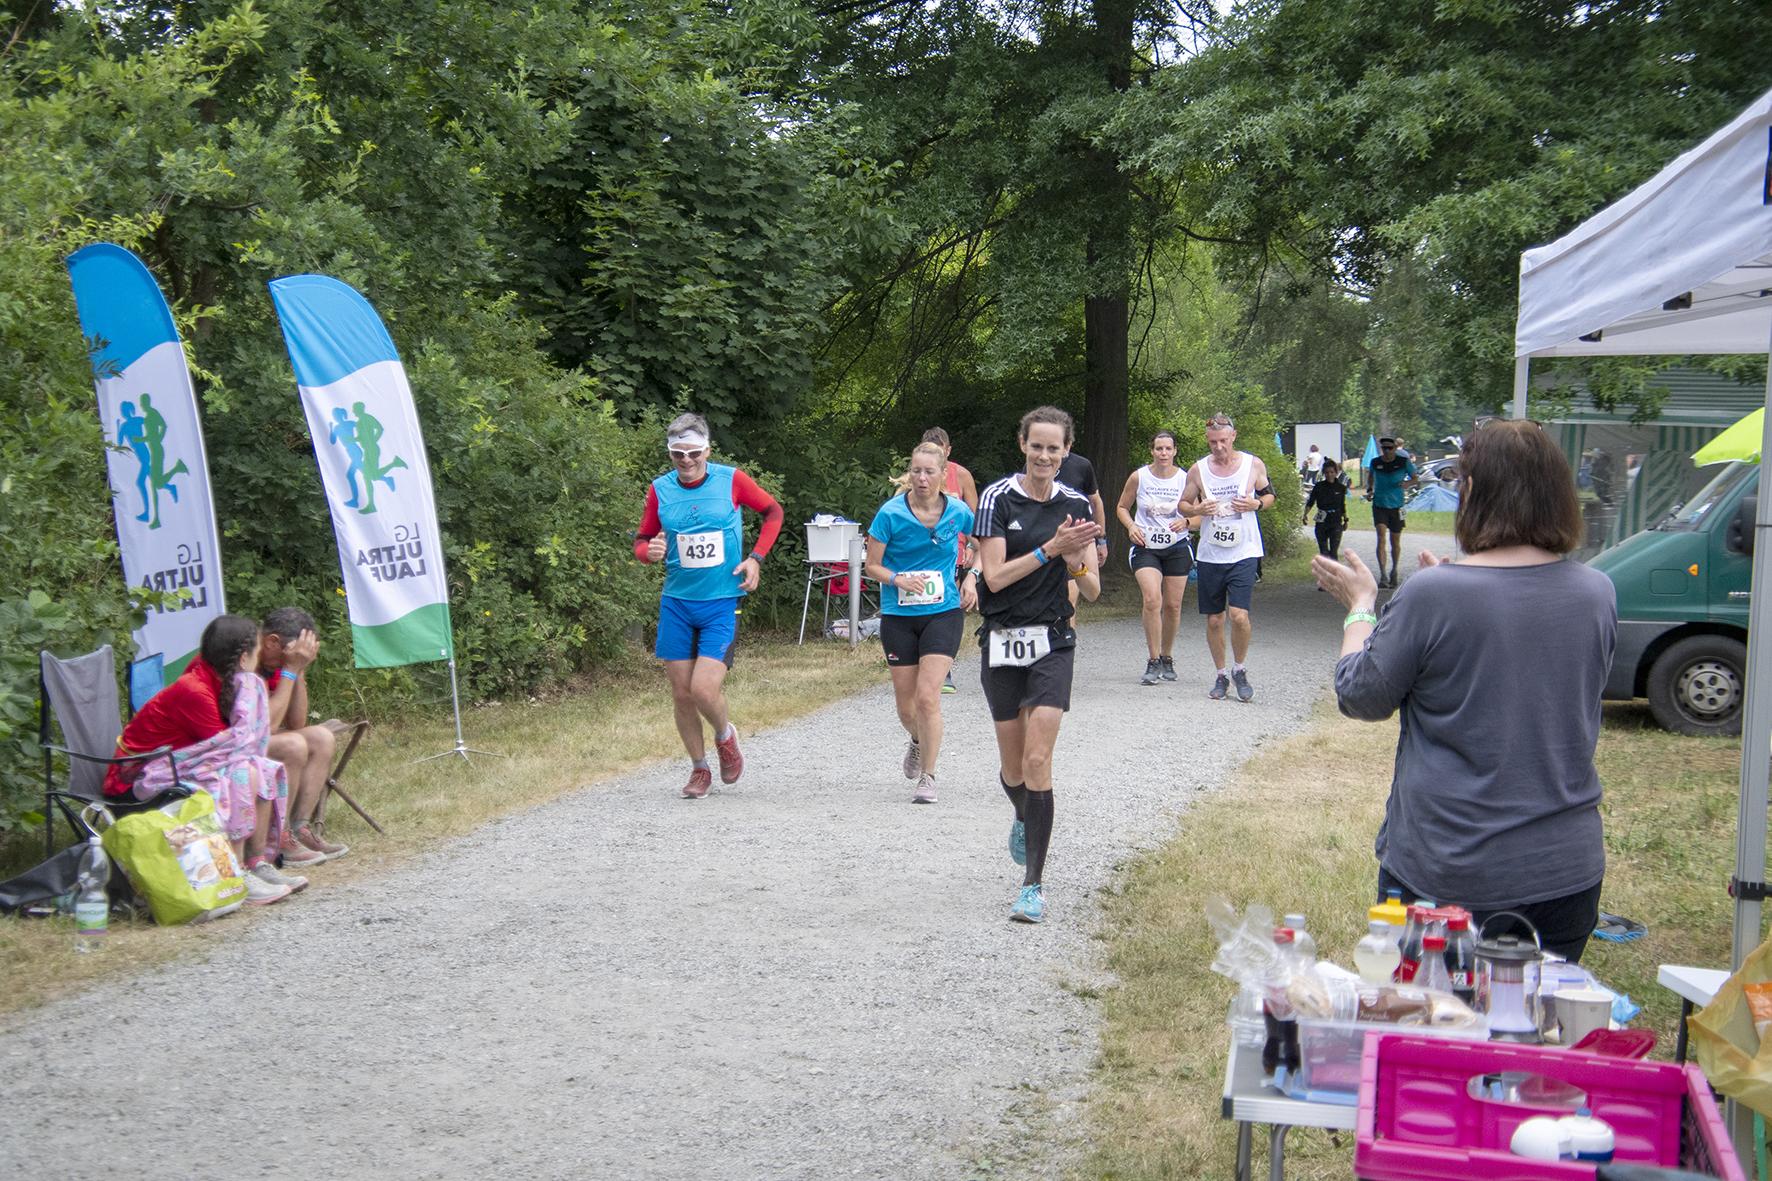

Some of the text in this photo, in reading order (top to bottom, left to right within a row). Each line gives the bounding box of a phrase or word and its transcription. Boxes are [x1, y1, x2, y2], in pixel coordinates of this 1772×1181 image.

[1150, 533, 1172, 544] 453
[1213, 531, 1235, 542] 454
[686, 543, 716, 560] 432
[1001, 639, 1037, 660] 101
